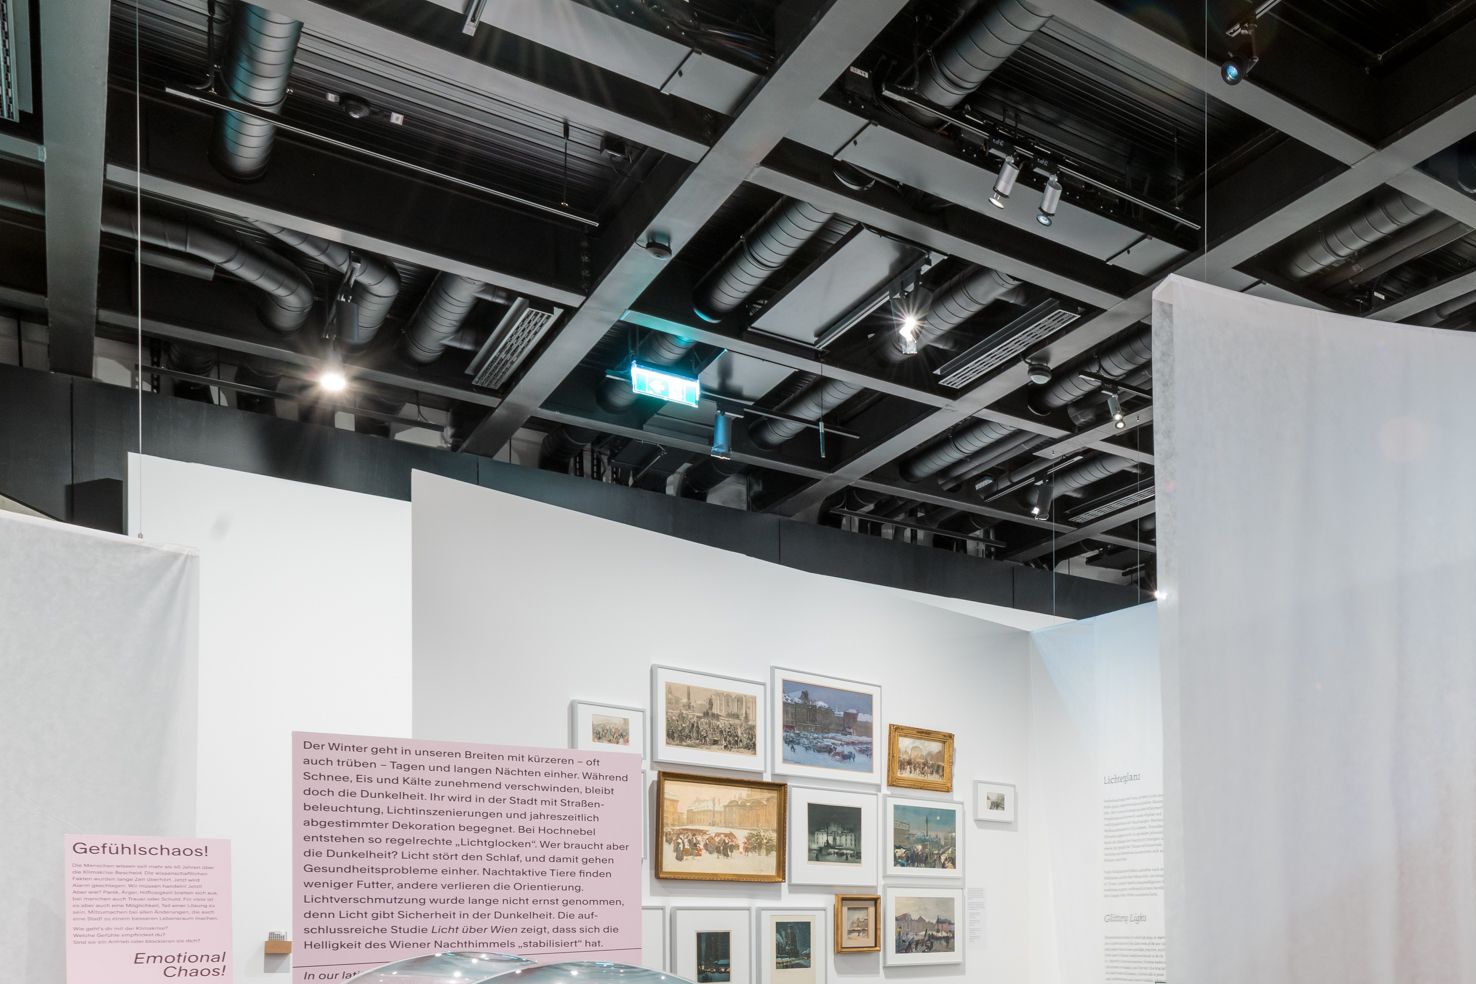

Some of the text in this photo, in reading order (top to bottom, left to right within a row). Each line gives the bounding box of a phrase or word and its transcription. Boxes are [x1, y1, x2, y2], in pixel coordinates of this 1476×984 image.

[303, 740, 325, 750] Der
[328, 742, 368, 753] Winter
[371, 745, 397, 756] geht
[401, 746, 411, 755] in
[415, 749, 461, 758] unseren
[465, 750, 504, 761] Breiten
[508, 754, 524, 762] mit
[528, 754, 574, 765] kürzeren
[586, 758, 600, 767] oft
[303, 757, 333, 766] auch
[337, 758, 377, 769] trüben
[390, 761, 425, 773] Tagen
[429, 764, 451, 773] und
[454, 764, 492, 776] langen
[495, 767, 541, 777] Nächten
[544, 770, 580, 779] einher.
[582, 771, 628, 782] Während
[303, 771, 614, 795] Schnee, Eis und Kälte zunehmend verschwinden, bleibt
[303, 787, 604, 808] doch die Dunkelheit. Ihr wird in der Stadt mit Straßen-
[303, 802, 599, 822] beleuchtung, Lichtinszenierungen und jahreszeitlich
[303, 818, 596, 836] abgestimmter Dekoration begegnet. Bei Hochnebel
[72, 842, 208, 857] Gefühlschaos!
[303, 834, 365, 844] entstehen
[385, 836, 453, 847] regelrechte
[539, 840, 561, 849] Wer
[563, 841, 603, 850] braucht
[606, 842, 629, 851] aber
[303, 848, 614, 866] die Dunkelheit? Licht stört den Schlaf, und damit gehen
[303, 864, 612, 878] Gesundheitsprobleme einher. Nachtaktive Tiere finden
[303, 880, 584, 894] weniger Futter, andere verlieren die Orientierung.
[304, 894, 625, 908] Lichtverschmutzung wurde lange nicht ernst genommen,
[303, 910, 598, 921] denn Licht gibt Sicherheit in der Dunkelheit. Die auf-
[303, 925, 619, 936] schlussreiche Studie Licht über Wien zeigt, dass sich die
[304, 940, 361, 951] Helligkeit
[364, 940, 387, 949] des
[389, 940, 431, 949] Wiener
[434, 940, 516, 949] Nachthimmels
[585, 939, 603, 948] hat.
[134, 952, 226, 964] Emotional
[163, 965, 226, 977] Chaos!
[303, 971, 315, 980] In
